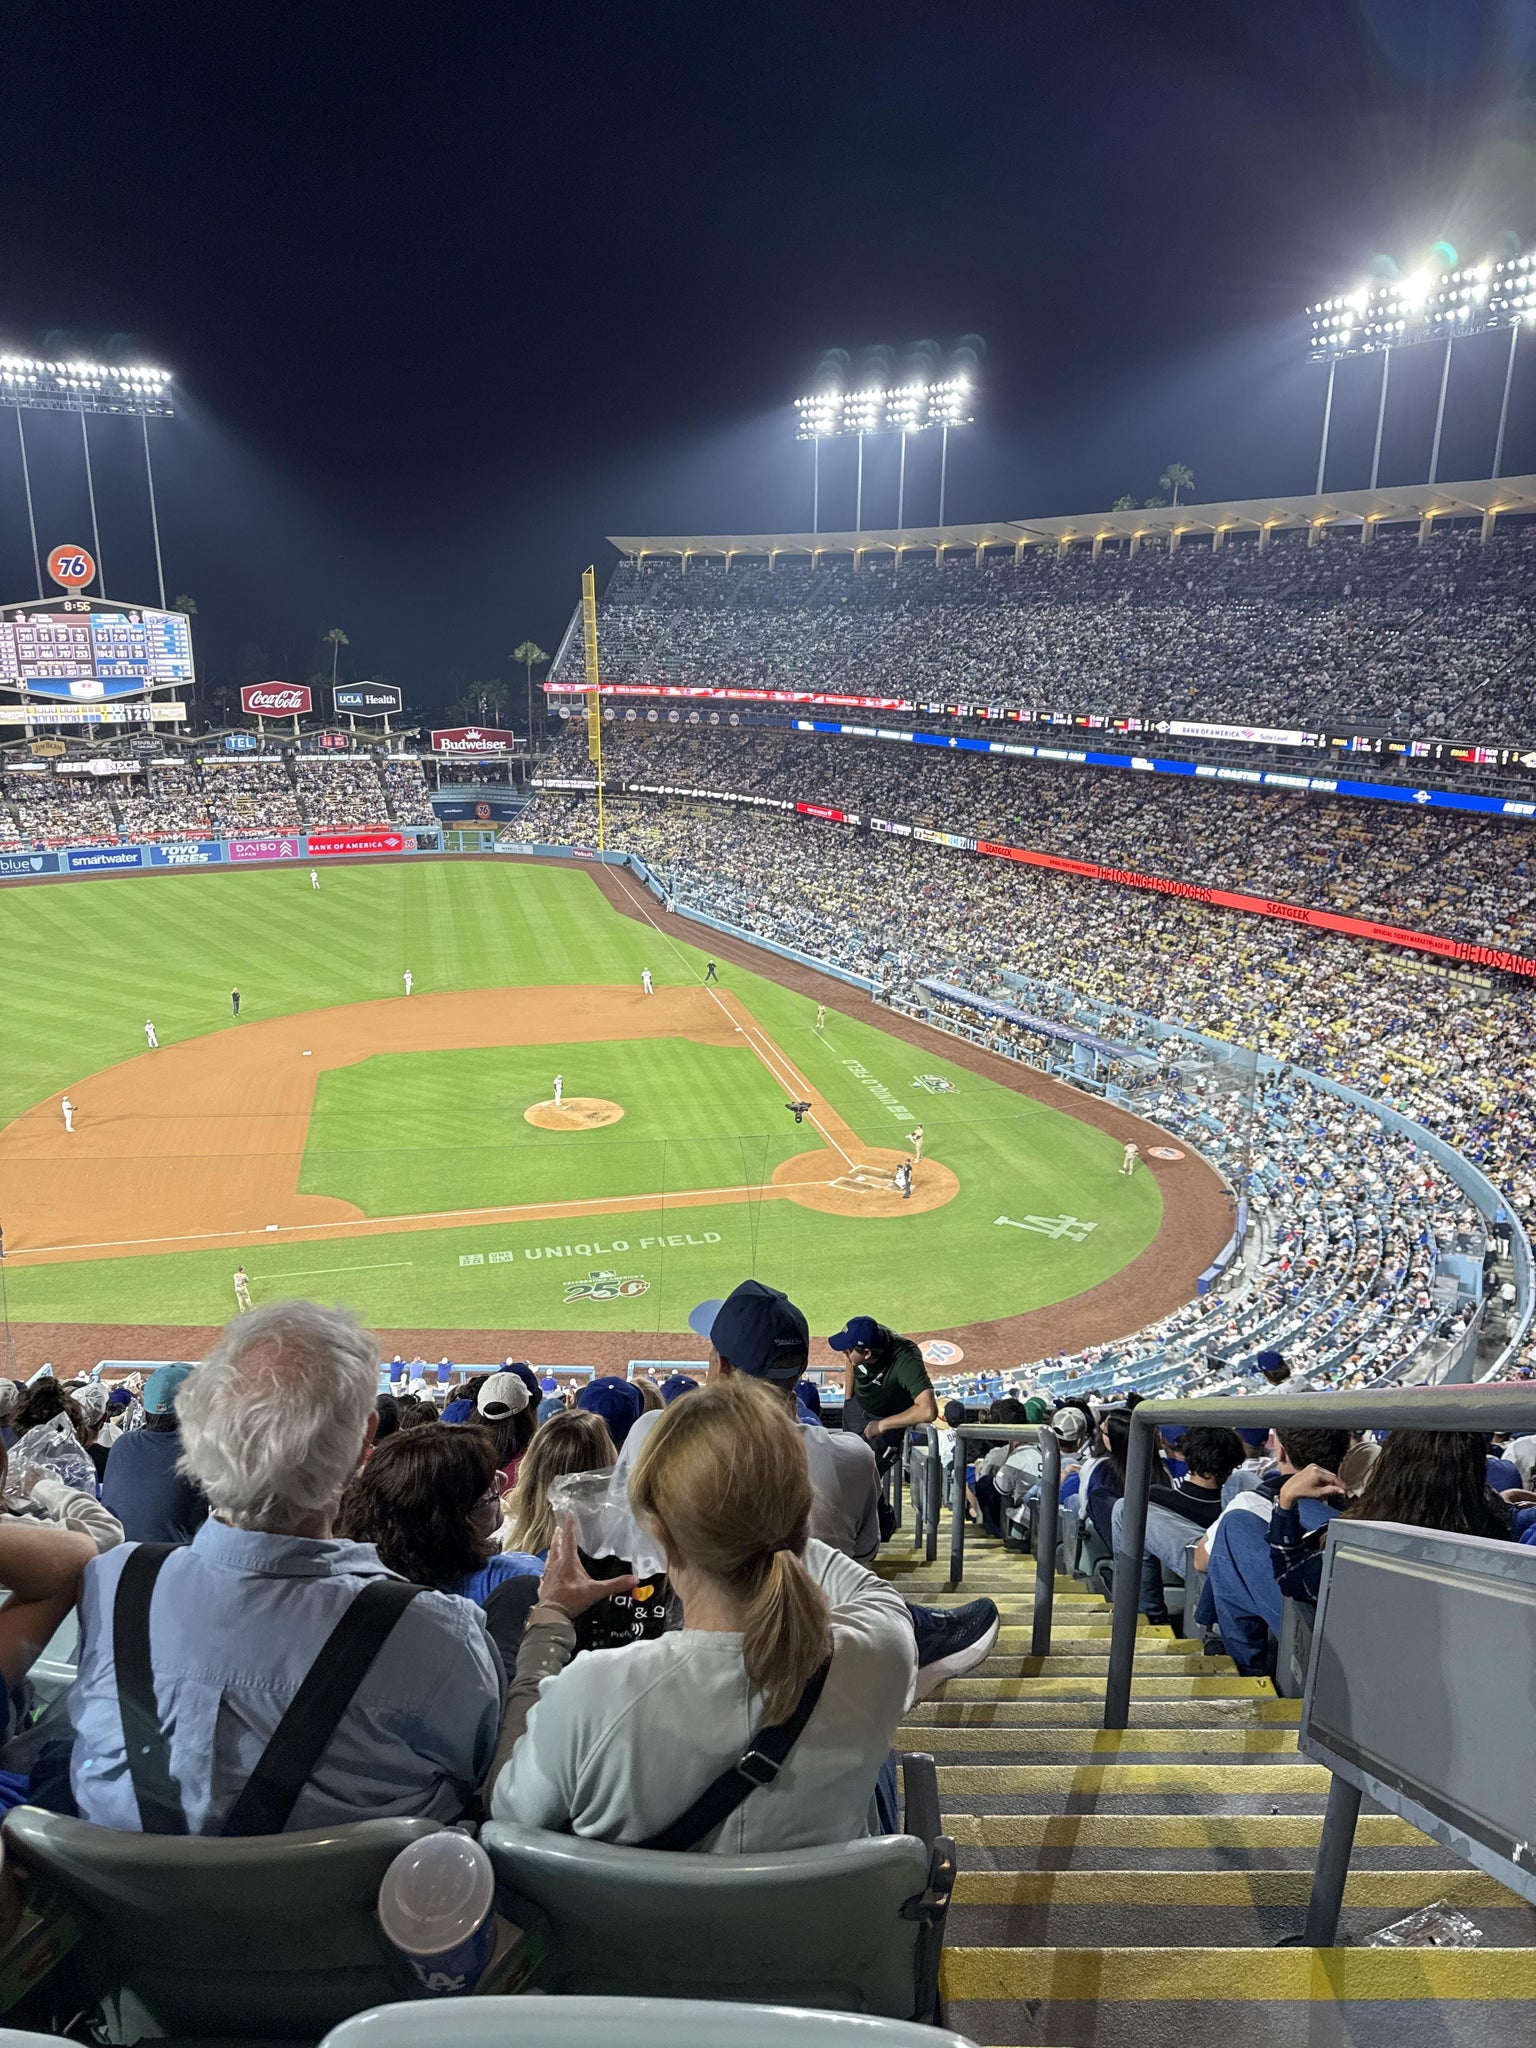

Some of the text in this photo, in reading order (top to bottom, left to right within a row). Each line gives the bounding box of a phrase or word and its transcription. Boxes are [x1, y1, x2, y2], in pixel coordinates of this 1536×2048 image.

[57, 556, 86, 577] 76
[64, 602, 91, 612] 8:56
[248, 690, 304, 708] Coca-Cola
[339, 695, 396, 704] UCLA Health
[1210, 729, 1240, 737] AMERICA
[229, 738, 253, 748] TEL
[440, 739, 506, 750] Budweiser
[478, 806, 489, 816] 76
[160, 845, 199, 855] TOYO
[236, 843, 276, 853] DAISO
[985, 844, 1012, 857] SEATGEEK
[0, 860, 30, 870] blue
[72, 853, 138, 866] smartwater
[168, 853, 209, 864] TIRES
[1130, 873, 1168, 891] ANGELES
[1168, 881, 1212, 902] DODGERS
[1266, 903, 1309, 922] SEATGEEK
[1373, 928, 1393, 936] OFFICIAL
[1393, 932, 1409, 941] TICKET
[1504, 952, 1536, 977] ANG
[861, 1079, 899, 1105] UNIQLO
[993, 1214, 1098, 1242] LA
[525, 1232, 721, 1260] UNIQLO FIELD
[926, 1343, 955, 1363] 76
[634, 1607, 648, 1618] &
